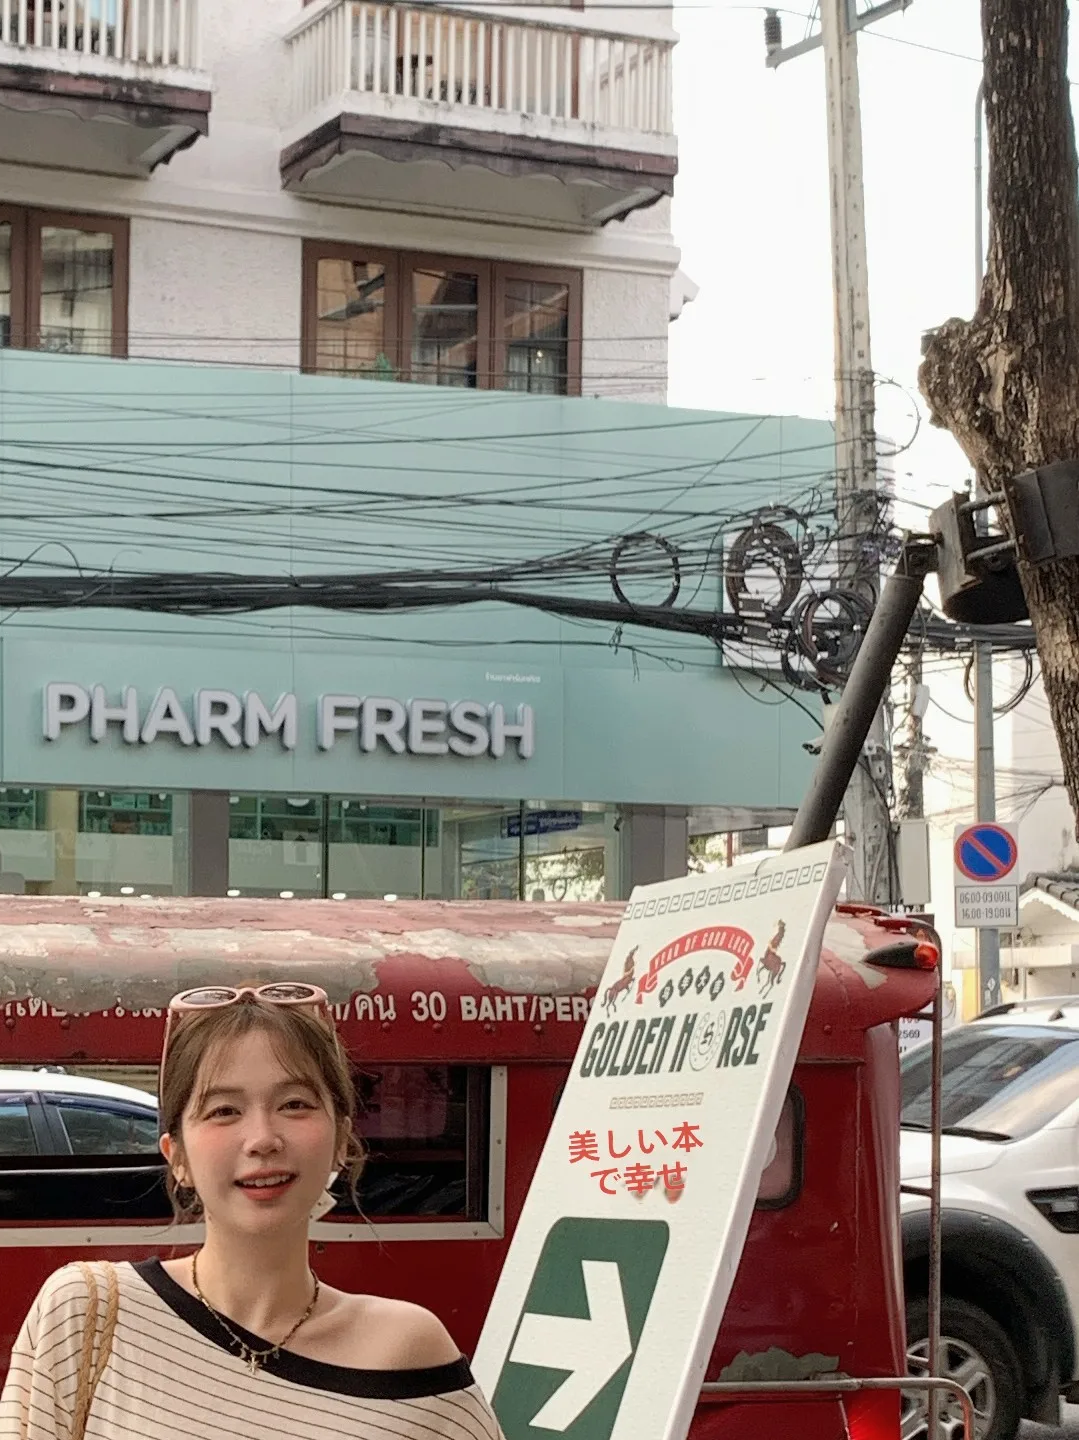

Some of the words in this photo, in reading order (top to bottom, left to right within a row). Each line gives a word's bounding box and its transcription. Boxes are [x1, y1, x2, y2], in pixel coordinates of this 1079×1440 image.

[41, 682, 297, 750] PHARM
[317, 694, 534, 759] FRESH
[412, 991, 446, 1021] 30
[580, 1015, 676, 1078] GOLDEN
[569, 1122, 704, 1164] 美しい本
[590, 1161, 688, 1195] で幸せ
